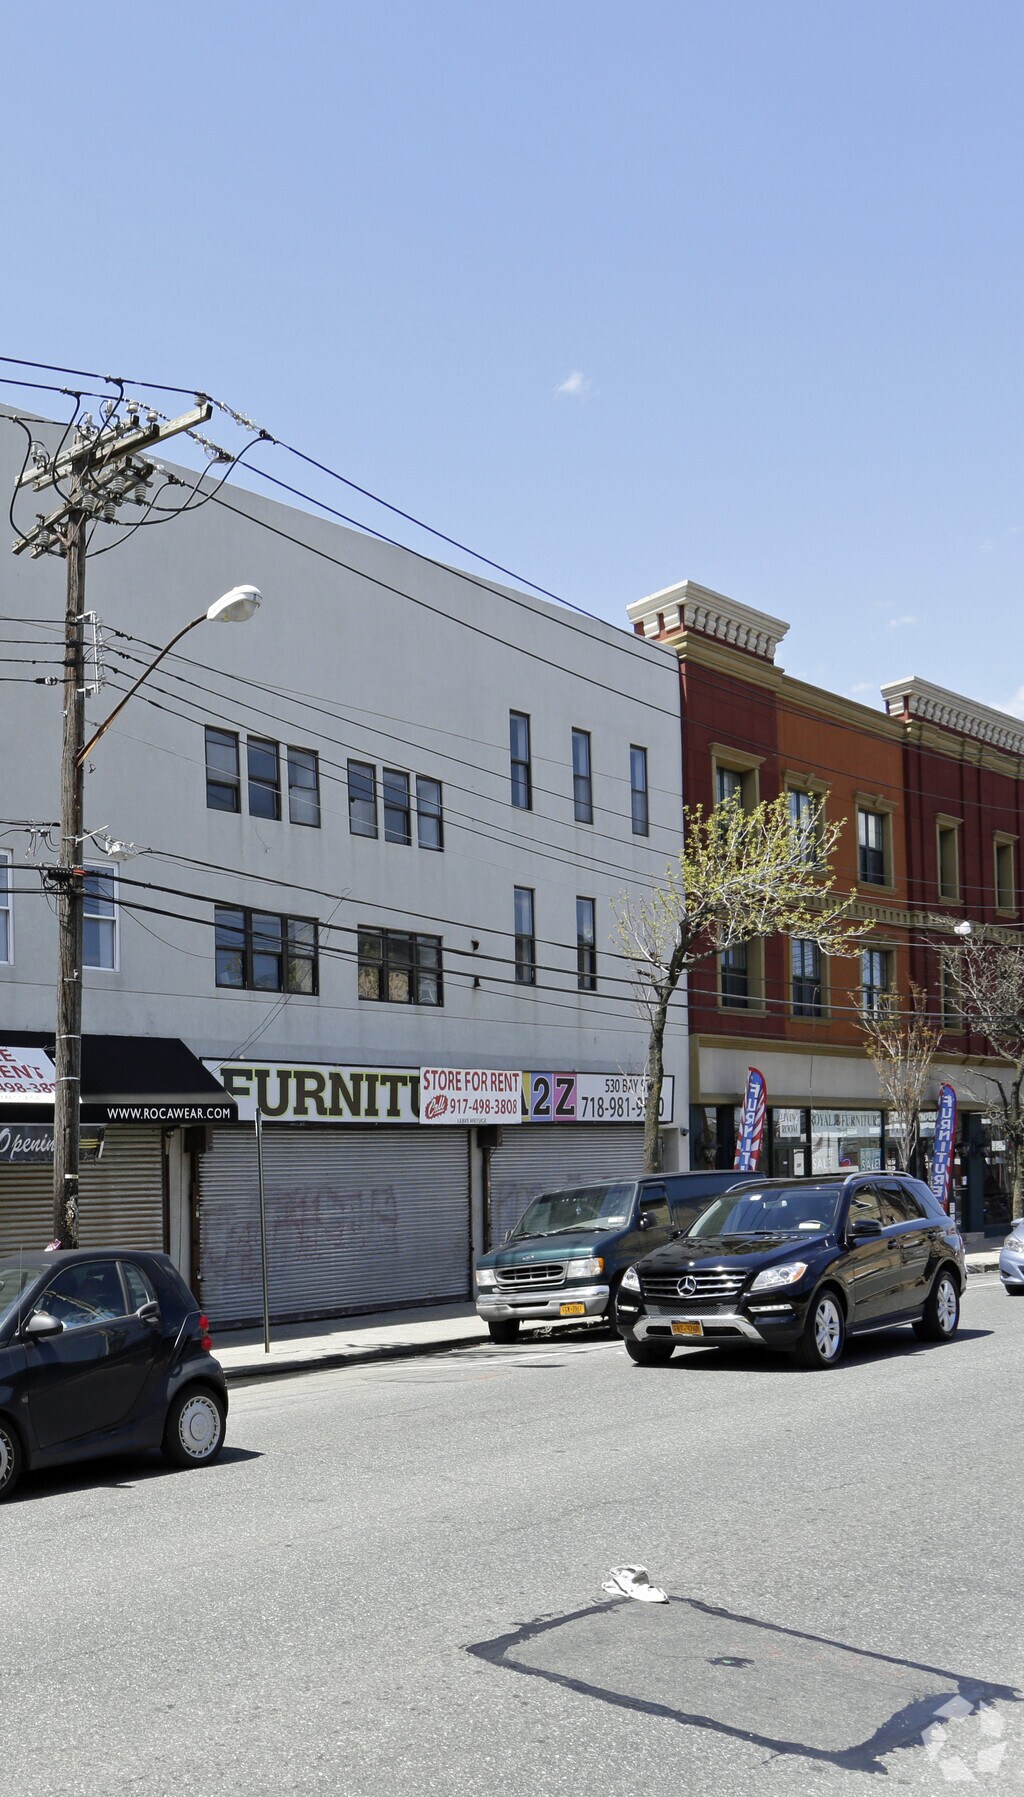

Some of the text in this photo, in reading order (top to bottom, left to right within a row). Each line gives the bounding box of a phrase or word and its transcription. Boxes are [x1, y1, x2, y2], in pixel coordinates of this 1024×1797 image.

[423, 1069, 519, 1092] STORE FOR RENT
[605, 1078, 620, 1093] 530
[622, 1079, 639, 1093] BAY
[107, 1108, 231, 1119] WWW.ROCAWEAR.COM
[428, 1095, 518, 1117] Call 917-498-3808
[581, 1096, 665, 1118] 718-981-90
